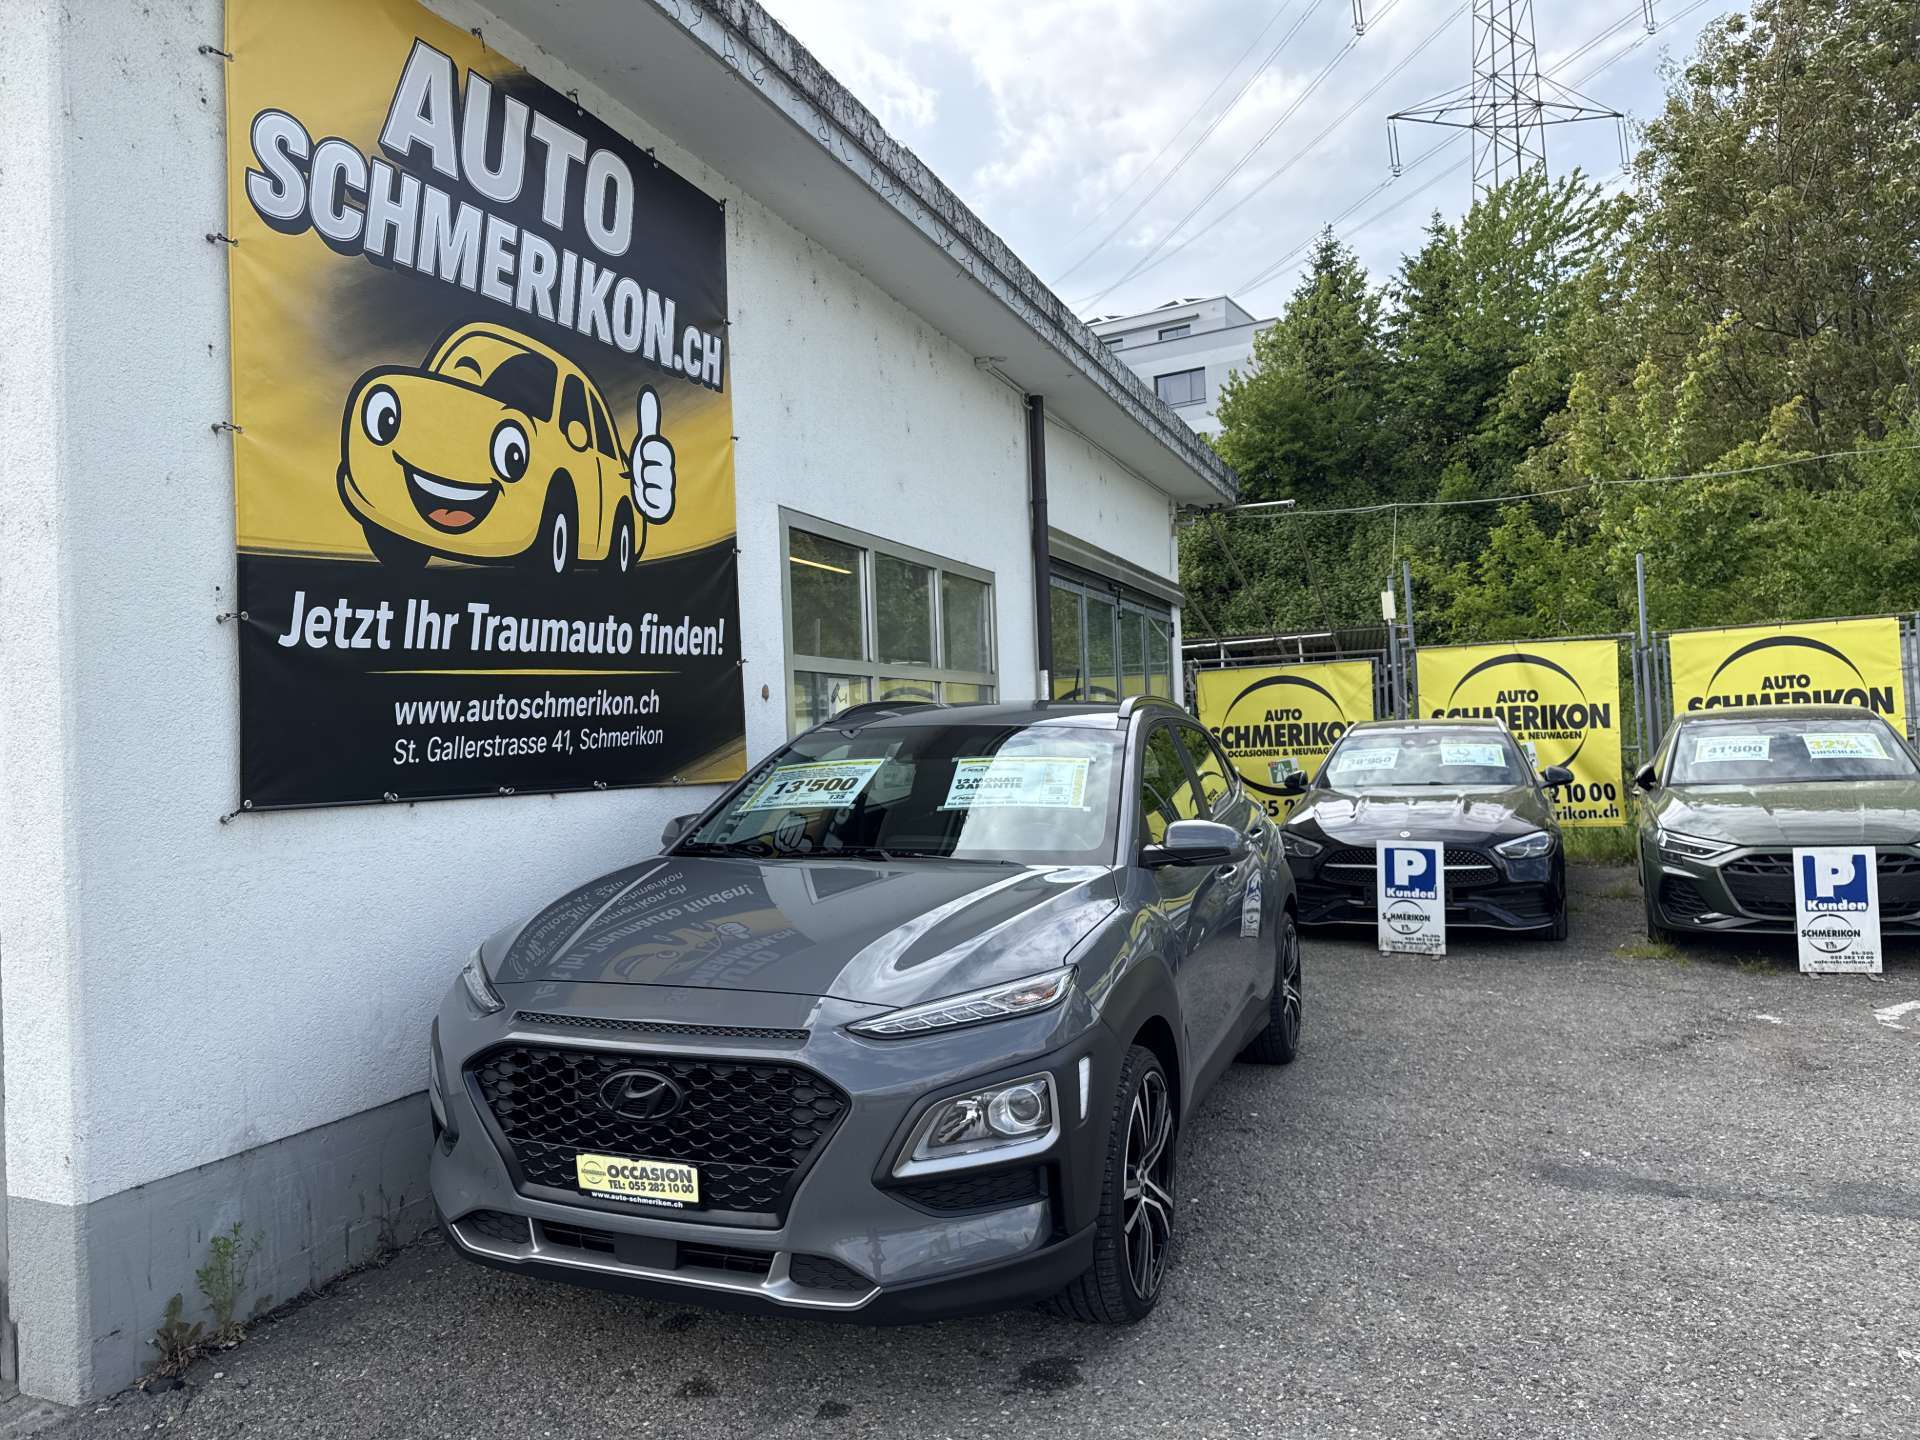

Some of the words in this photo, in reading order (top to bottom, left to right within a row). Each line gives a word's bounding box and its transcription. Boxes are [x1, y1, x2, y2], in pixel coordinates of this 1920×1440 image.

[379, 37, 635, 257] AUTO
[247, 109, 722, 386] SCHMERIKON.CH
[277, 590, 395, 650] Jetzt
[403, 598, 460, 651] Ihr
[467, 602, 633, 655] Traumauto
[639, 612, 725, 656] finden!
[1761, 674, 1811, 690] AUTO
[1495, 689, 1539, 704] AUTO
[394, 688, 660, 726] www.autoschmerikon.ch
[1264, 708, 1303, 722] AUTO
[1209, 721, 1355, 749] SCHMERIKO
[1517, 732, 1525, 740] &
[1528, 731, 1582, 740] NEUWAGEN
[392, 738, 420, 765] St.
[427, 735, 547, 762] Gallerstrasse
[552, 729, 574, 755] 41,
[579, 725, 664, 751] Schmerikon
[1227, 748, 1280, 758] OCCASIONEN
[1281, 748, 1289, 756] &
[773, 777, 859, 795] 13'500
[1589, 782, 1616, 802] 00
[1393, 849, 1427, 886] P
[1386, 887, 1436, 899] Kunden
[1807, 899, 1867, 911] Kunden
[1801, 929, 1861, 938] SCHMERIKON
[606, 1164, 693, 1184] OCCASION
[607, 1179, 626, 1191] TEL:
[628, 1180, 647, 1191] 055
[648, 1182, 667, 1193] 282
[668, 1183, 680, 1193] 10
[681, 1183, 694, 1194] 00
[591, 1190, 684, 1209] www.auto-schmerikon.ch
